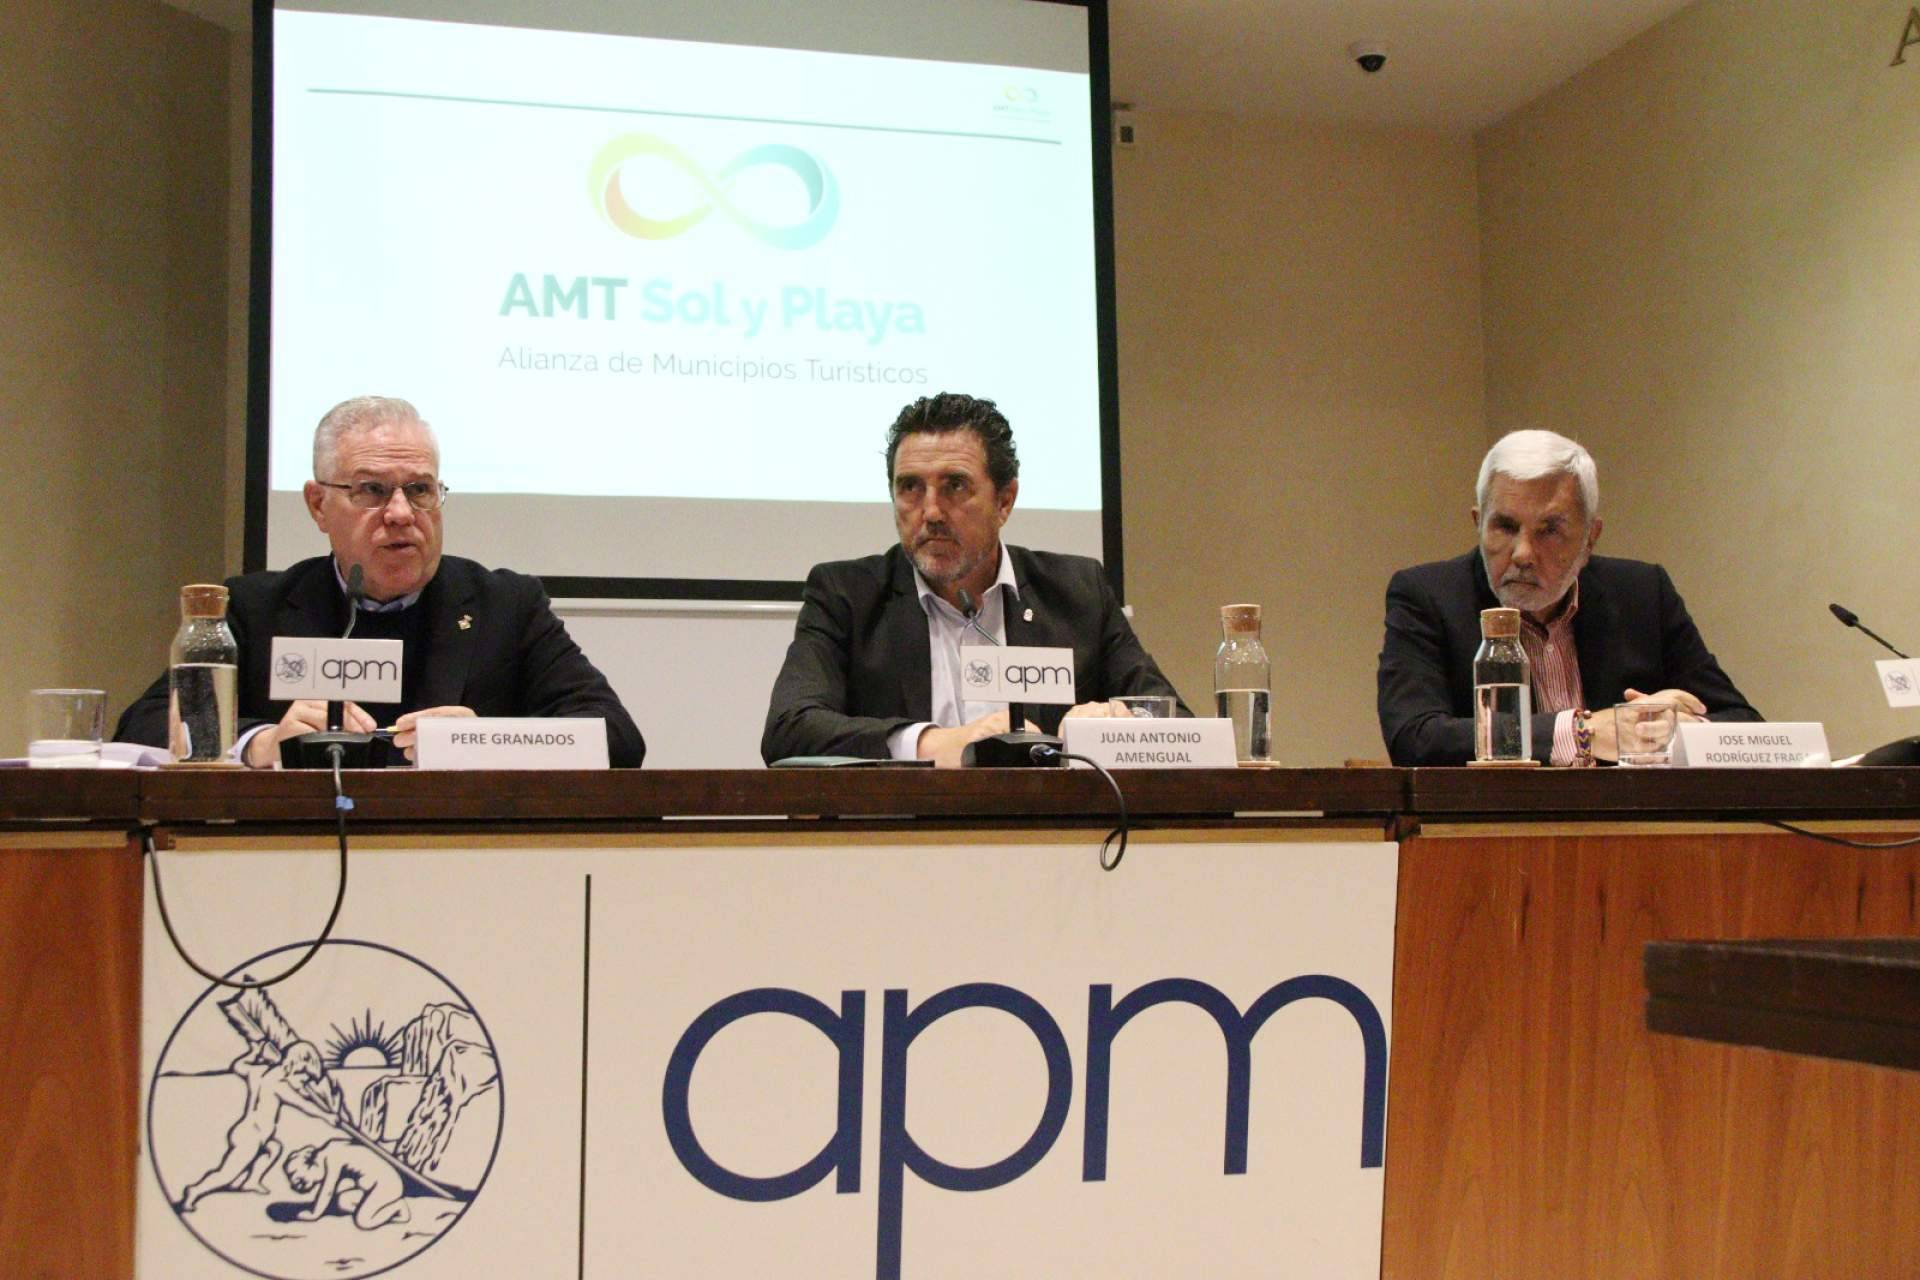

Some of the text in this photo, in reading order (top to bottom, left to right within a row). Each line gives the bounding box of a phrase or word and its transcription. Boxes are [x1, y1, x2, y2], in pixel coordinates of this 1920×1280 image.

[499, 272, 926, 346] AMT Sol y Playa
[498, 346, 599, 372] Alianza
[608, 351, 643, 374] de
[653, 353, 797, 383] Municipios
[321, 657, 398, 689] apm
[1005, 664, 1072, 693] apm
[451, 732, 576, 746] PERE GRANADOS
[1100, 732, 1202, 744] JUAN ANTONIO
[1718, 735, 1793, 746] JOSE MIGUEL
[1115, 751, 1192, 764] AMENGUAL
[1705, 750, 1772, 764] RODRÍGUEZ
[662, 974, 1388, 1280] apm
